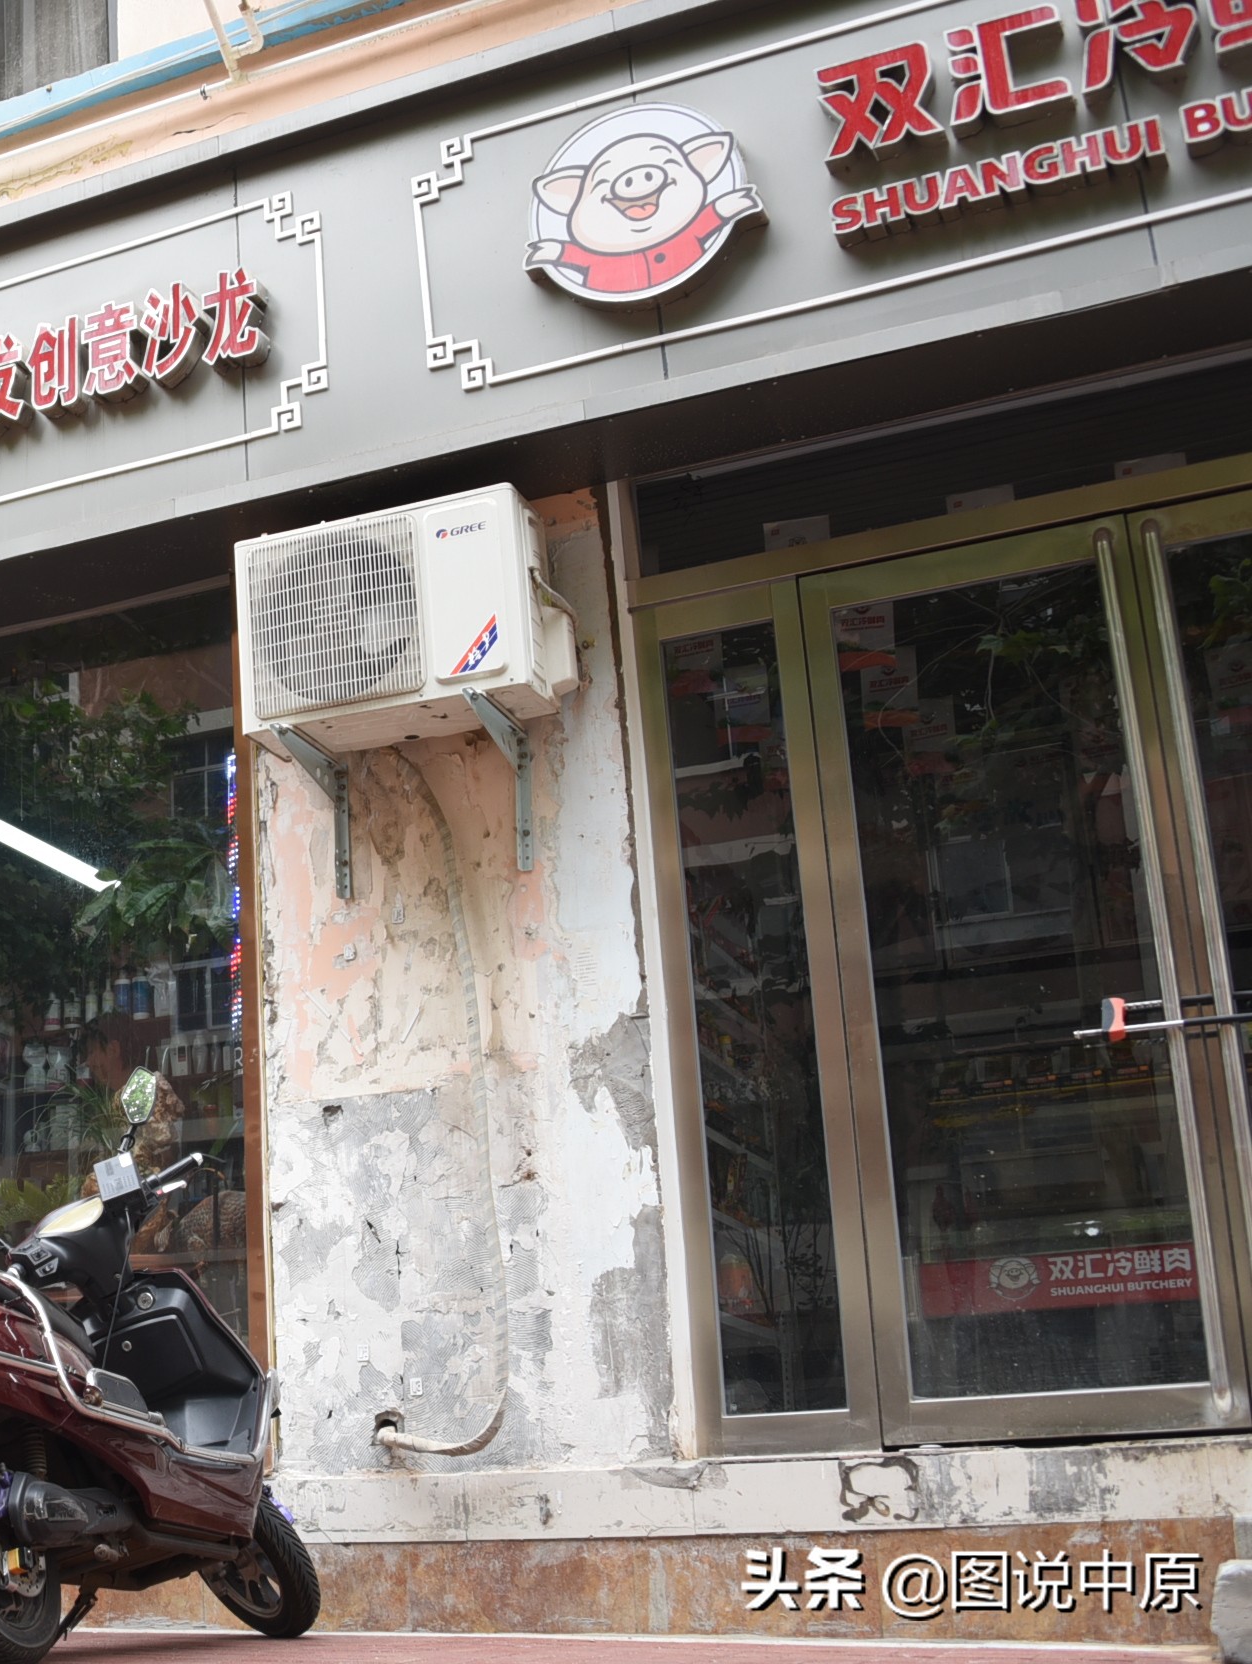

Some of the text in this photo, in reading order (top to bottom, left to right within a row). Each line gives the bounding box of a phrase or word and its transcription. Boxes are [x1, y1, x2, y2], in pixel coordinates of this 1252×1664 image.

[830, 114, 1165, 236] SHUANGHUI
[450, 520, 486, 537] GREE
[1048, 1248, 1192, 1281] 双汇冷鲜肉
[1050, 1278, 1192, 1297] SHUANGHUI BUTCHERY
